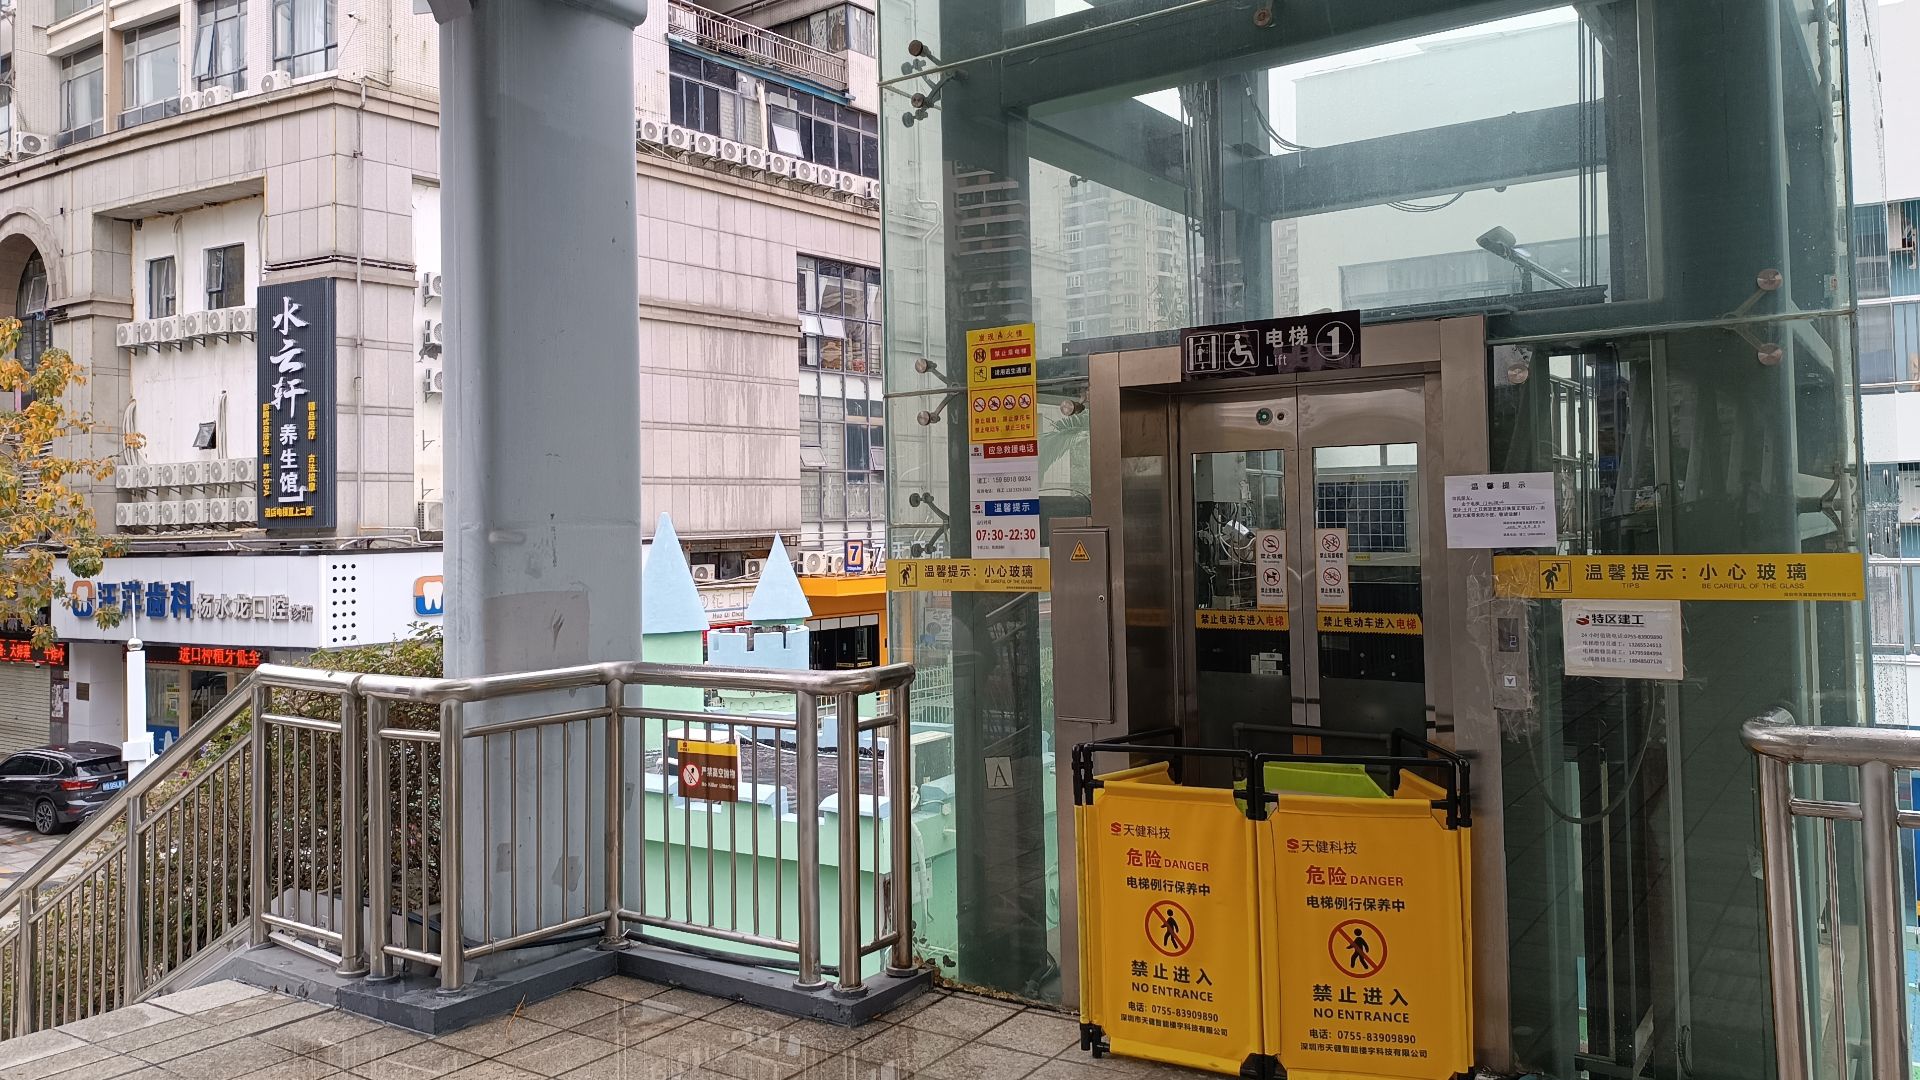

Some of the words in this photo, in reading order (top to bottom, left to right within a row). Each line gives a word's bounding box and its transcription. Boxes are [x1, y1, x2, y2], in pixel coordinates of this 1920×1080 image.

[1265, 324, 1309, 348] 电梯
[1326, 326, 1340, 356] 1
[270, 296, 309, 418] 水云轩
[1266, 354, 1287, 367] Lift
[279, 423, 299, 493] 养生馆
[988, 444, 1034, 455] 应急救援电话
[994, 502, 1031, 513] 温馨提示
[976, 528, 1036, 541] 07:30-22:30
[850, 545, 859, 561] 7
[1200, 613, 1285, 627] 禁止电动车进入电梯
[1323, 615, 1417, 631] 禁止电动车进入电梯
[1591, 613, 1645, 625] 特区建工
[1509, 635, 1517, 648] 2
[992, 763, 1010, 787] A
[1124, 823, 1171, 840] 天健科技
[1301, 839, 1358, 855] 天健科技
[1126, 847, 1162, 869] 危险
[1164, 858, 1209, 872] DANGER
[1305, 864, 1347, 886] 危险
[1350, 875, 1404, 887] DANGER
[1126, 876, 1211, 896] 电梯例行保养中
[1306, 895, 1406, 913] 电梯例行保养中
[1131, 959, 1213, 986] 禁止进入
[1131, 981, 1149, 993] NO
[1152, 984, 1214, 1003] ENTRANCE
[1312, 983, 1409, 1007] 禁止进入
[1313, 1007, 1334, 1018] NO
[1337, 1008, 1410, 1024] ENTRANCE
[1120, 1012, 1228, 1037] 深圳市天健智能楼宇科技有限公司
[1300, 1042, 1428, 1059] 深圳市天健智能楼宇科技有限公司
